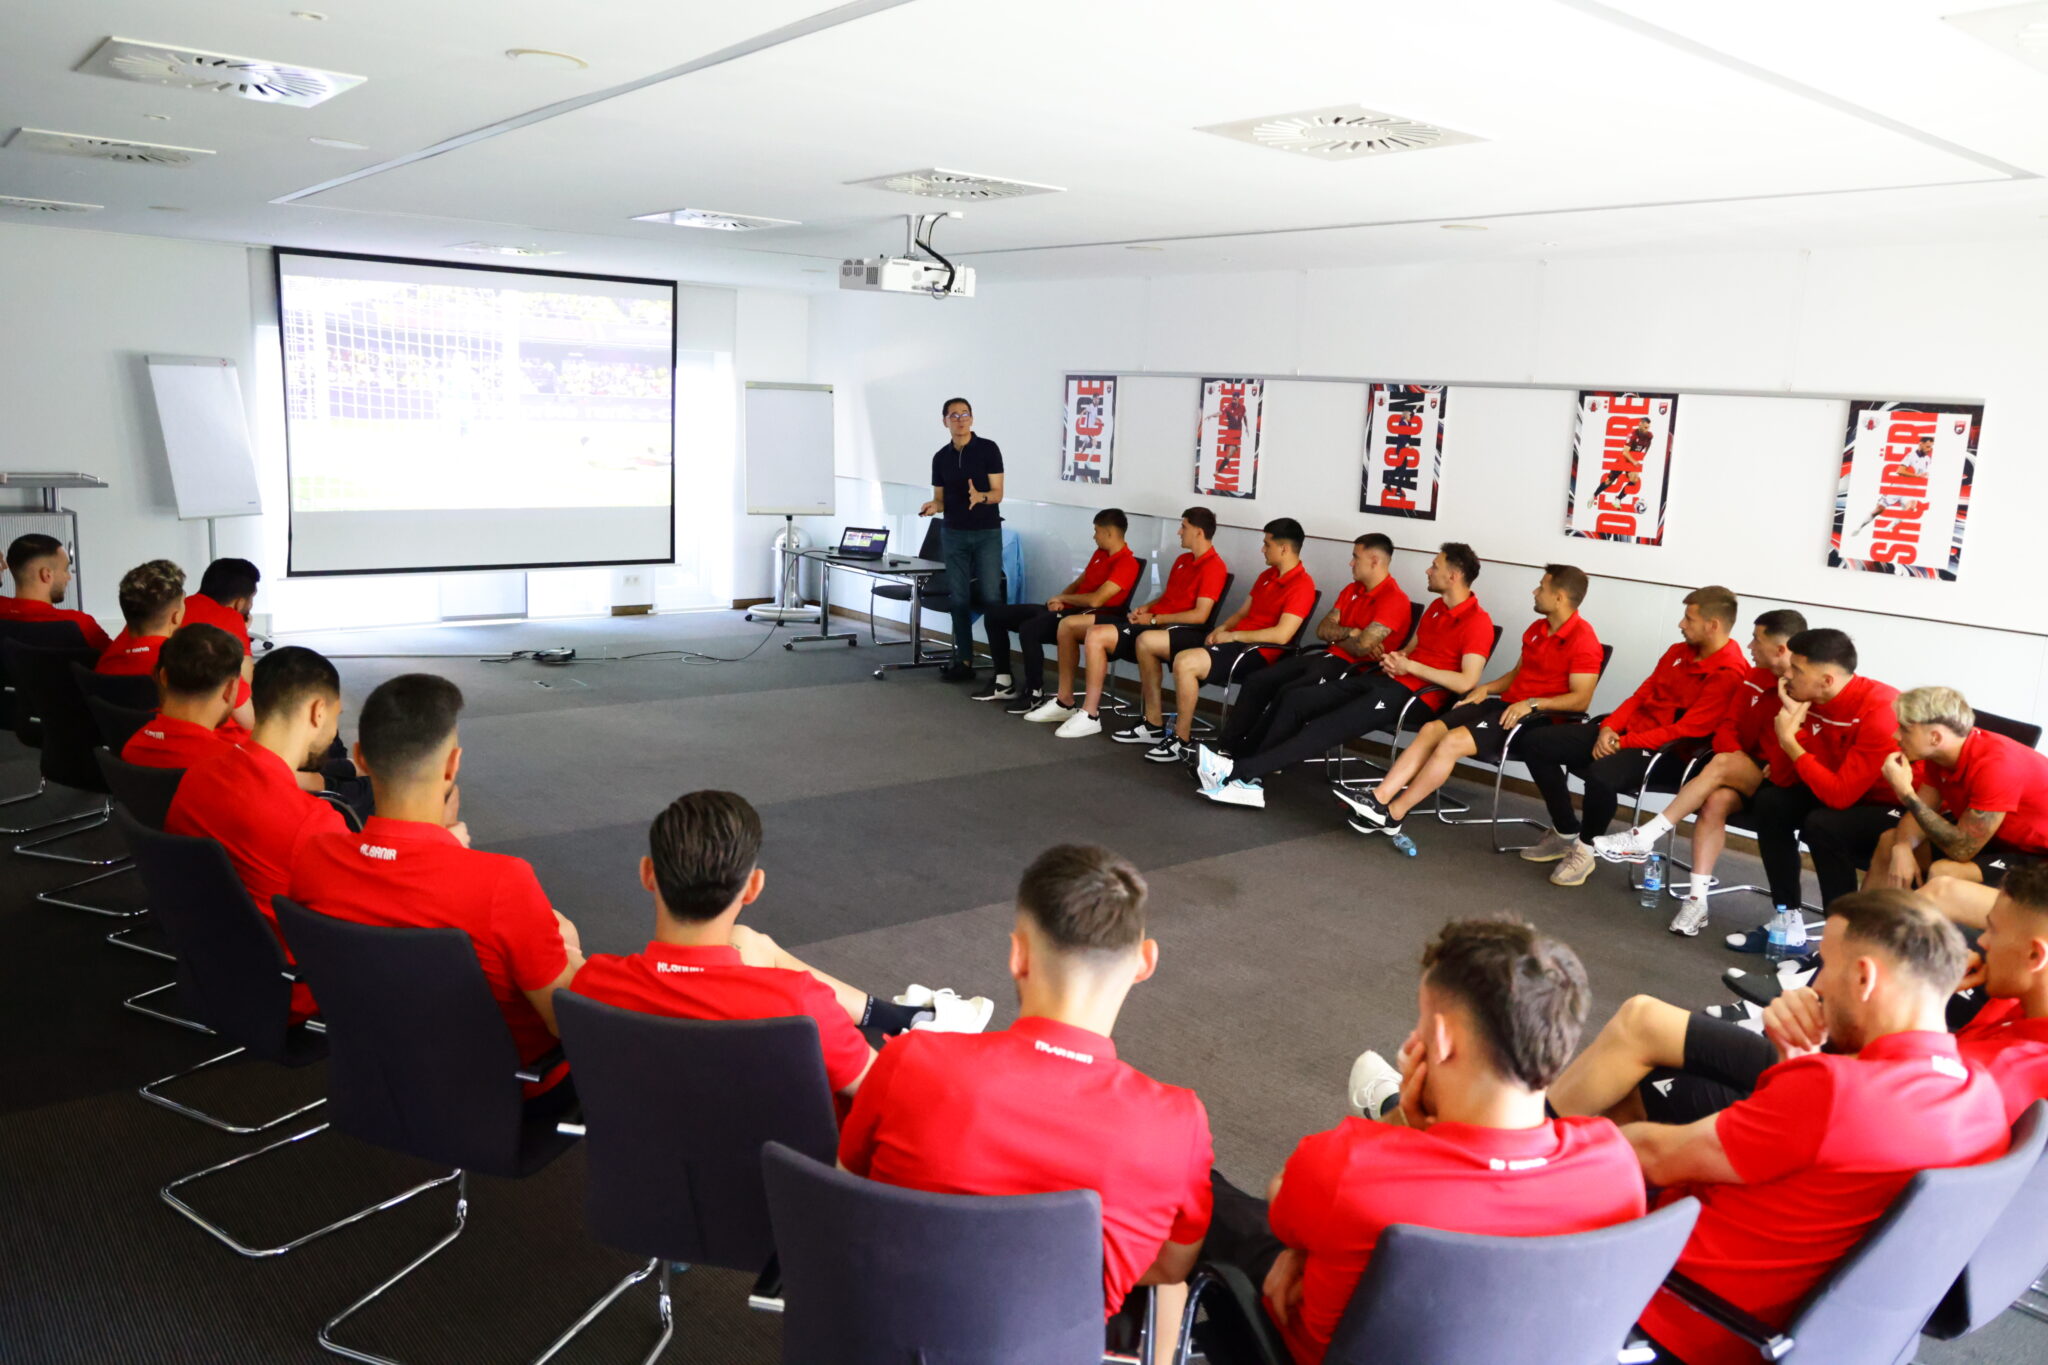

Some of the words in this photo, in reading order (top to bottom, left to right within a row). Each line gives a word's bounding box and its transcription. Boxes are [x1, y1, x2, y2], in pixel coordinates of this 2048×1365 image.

[1214, 383, 1245, 492] KRENARË
[1381, 391, 1425, 510] PASION
[1594, 397, 1651, 536] DËSHIRË
[1870, 411, 1939, 565] SHQIPËRI
